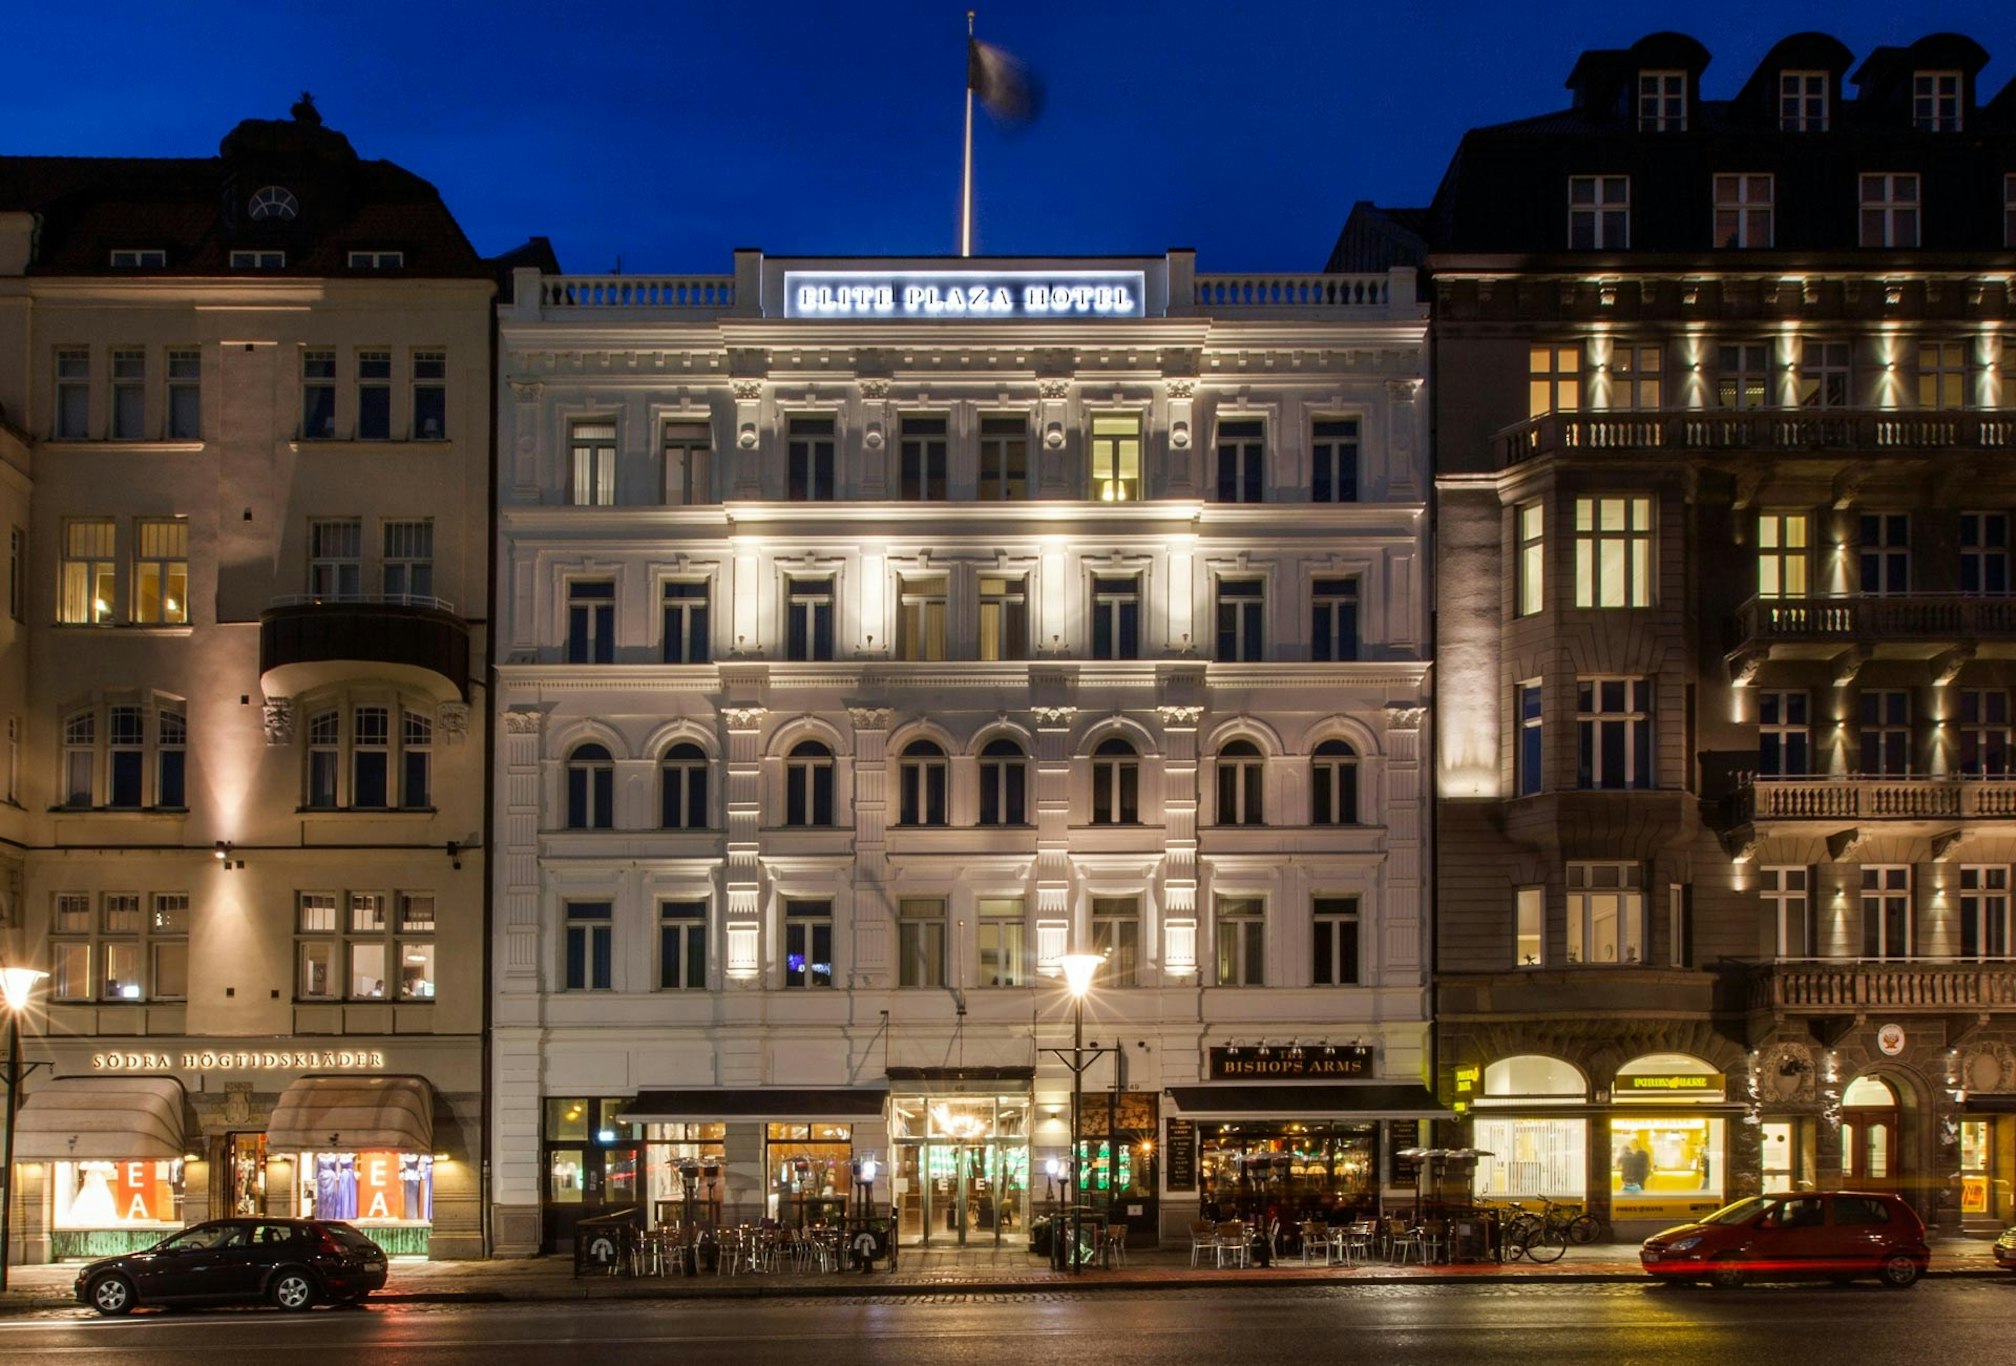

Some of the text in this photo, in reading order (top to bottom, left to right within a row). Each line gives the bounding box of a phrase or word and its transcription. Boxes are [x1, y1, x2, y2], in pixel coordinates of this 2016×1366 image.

[801, 287, 1134, 306] ELITE PLAZA HOTEL
[92, 1052, 384, 1068] SÖDRA HÖGTIDSKLÄDER
[1224, 1060, 1362, 1073] BISHOPS ARMS
